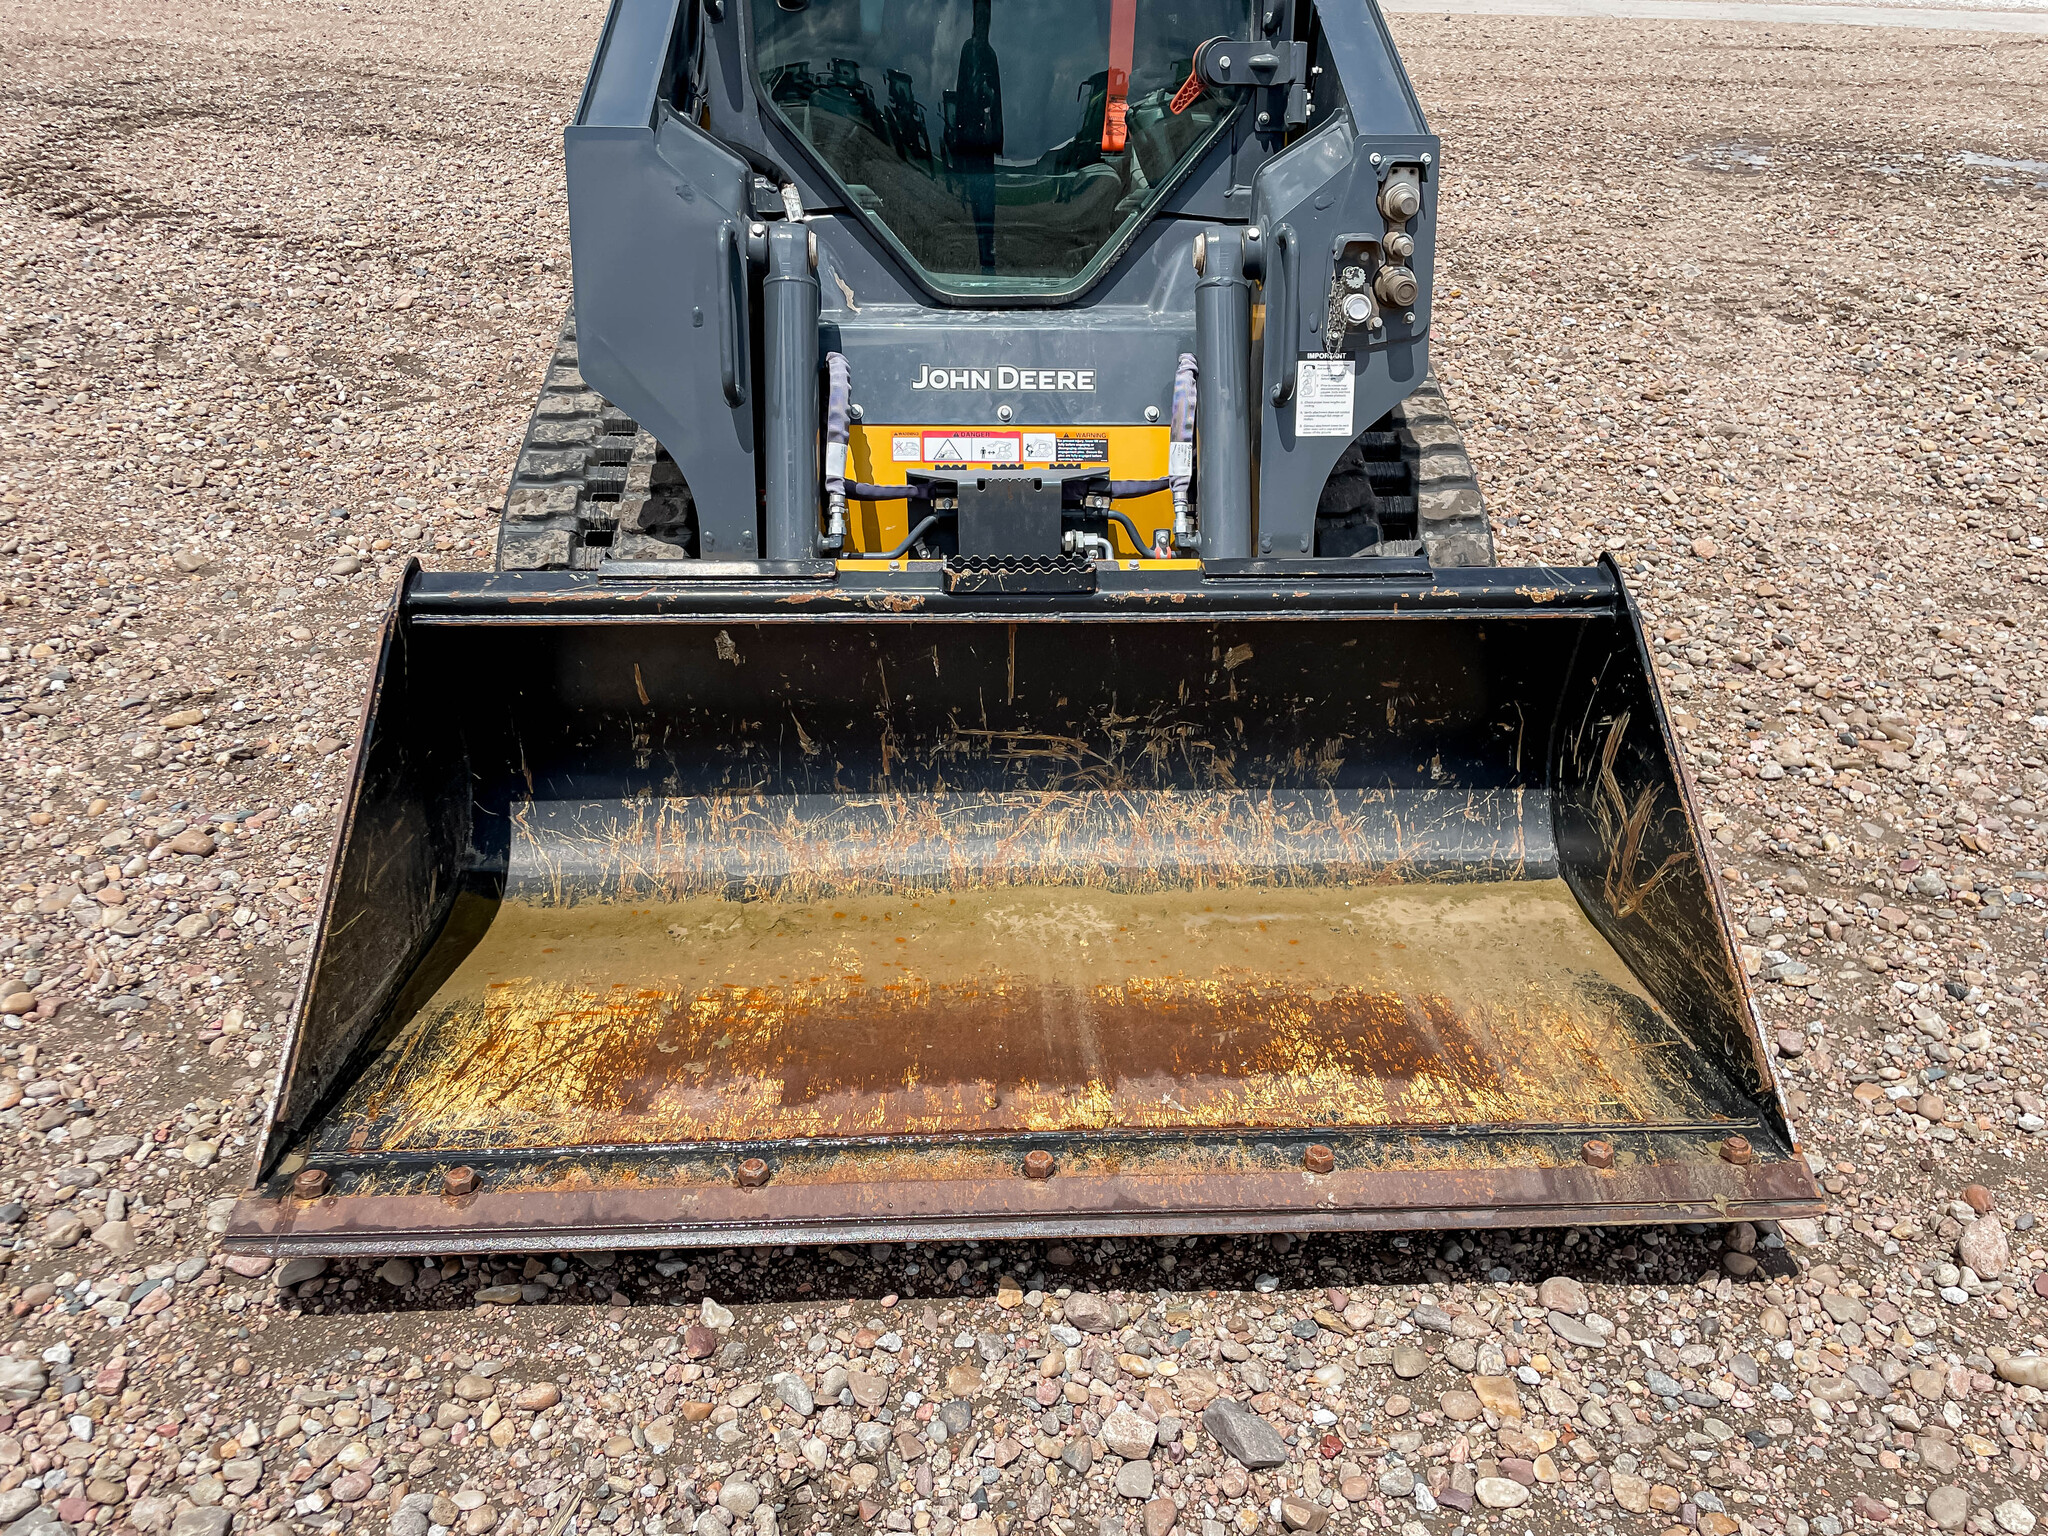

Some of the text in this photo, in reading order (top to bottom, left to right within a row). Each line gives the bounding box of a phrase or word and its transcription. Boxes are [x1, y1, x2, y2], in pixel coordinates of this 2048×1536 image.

[1306, 352, 1347, 360] IMPORTANT
[912, 365, 1095, 390] JOHN DEERE
